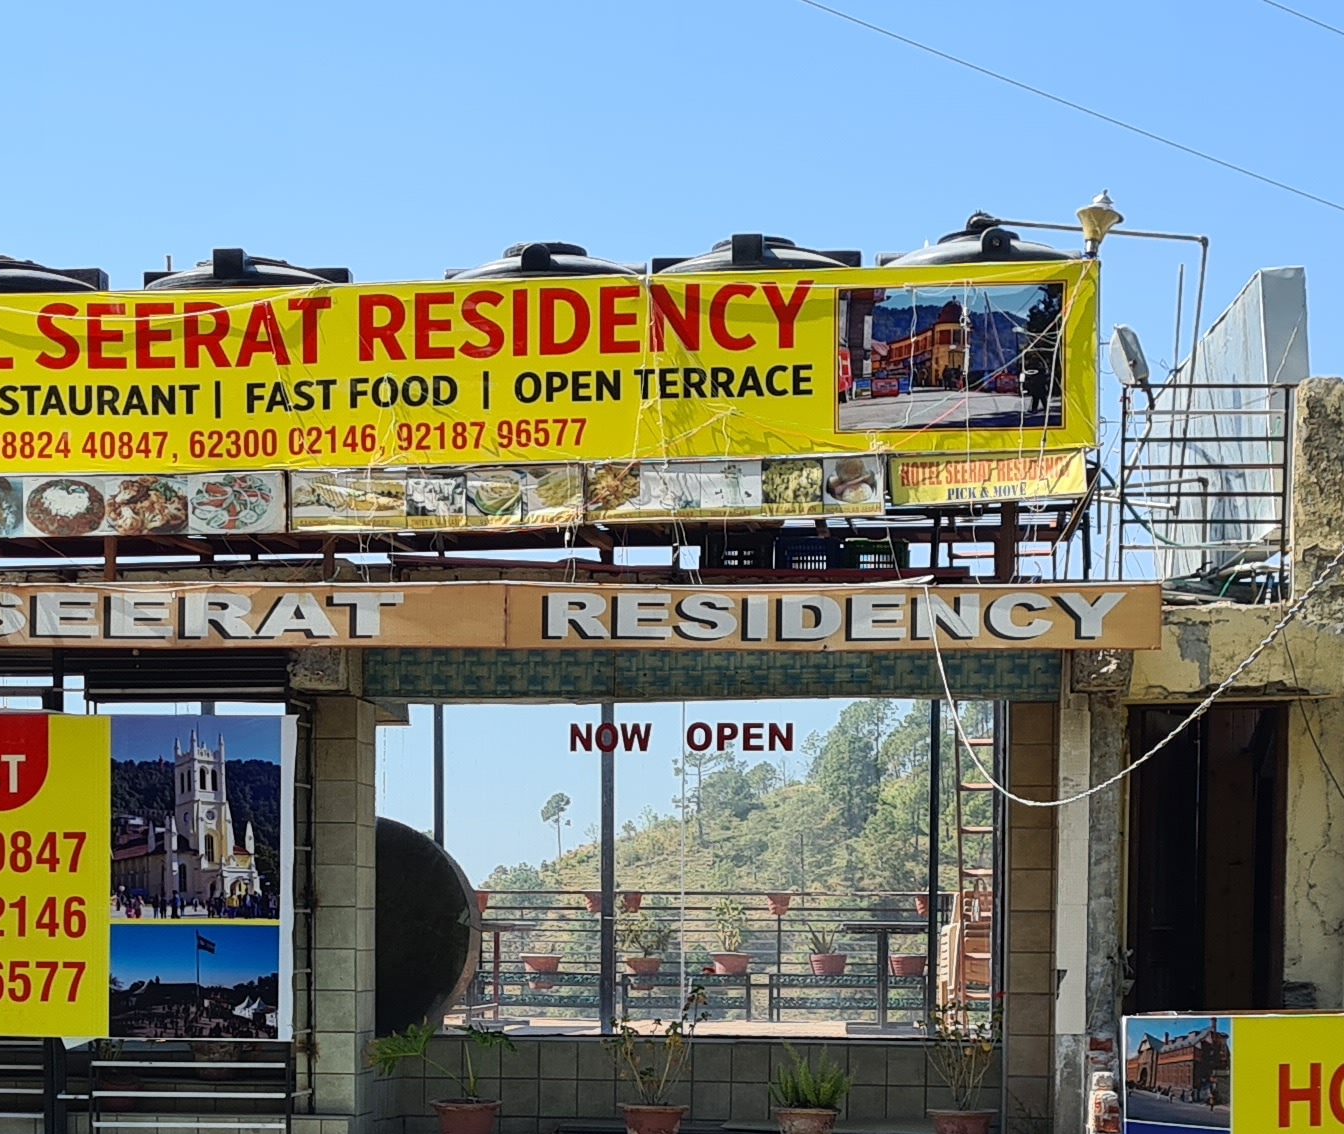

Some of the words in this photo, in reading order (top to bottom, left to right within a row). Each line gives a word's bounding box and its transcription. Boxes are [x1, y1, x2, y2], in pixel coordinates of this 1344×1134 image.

[35, 296, 332, 370] SEERAT
[358, 279, 814, 362] RESIDENCY
[246, 379, 337, 414] FAST
[349, 375, 458, 409] FOOD
[514, 369, 621, 404] OPEN
[633, 364, 813, 400] TERRACE
[81, 431, 178, 462] 40847,
[189, 428, 278, 459] 62300
[288, 423, 385, 458] 02146,
[396, 421, 486, 451] 92187
[497, 417, 587, 449] 96577
[947, 486, 977, 500] PICK
[980, 486, 991, 498] &
[993, 482, 1026, 498] MOVE
[542, 591, 1124, 642] RESIDENCY
[569, 722, 652, 752] NOW
[687, 722, 795, 752] OPEN
